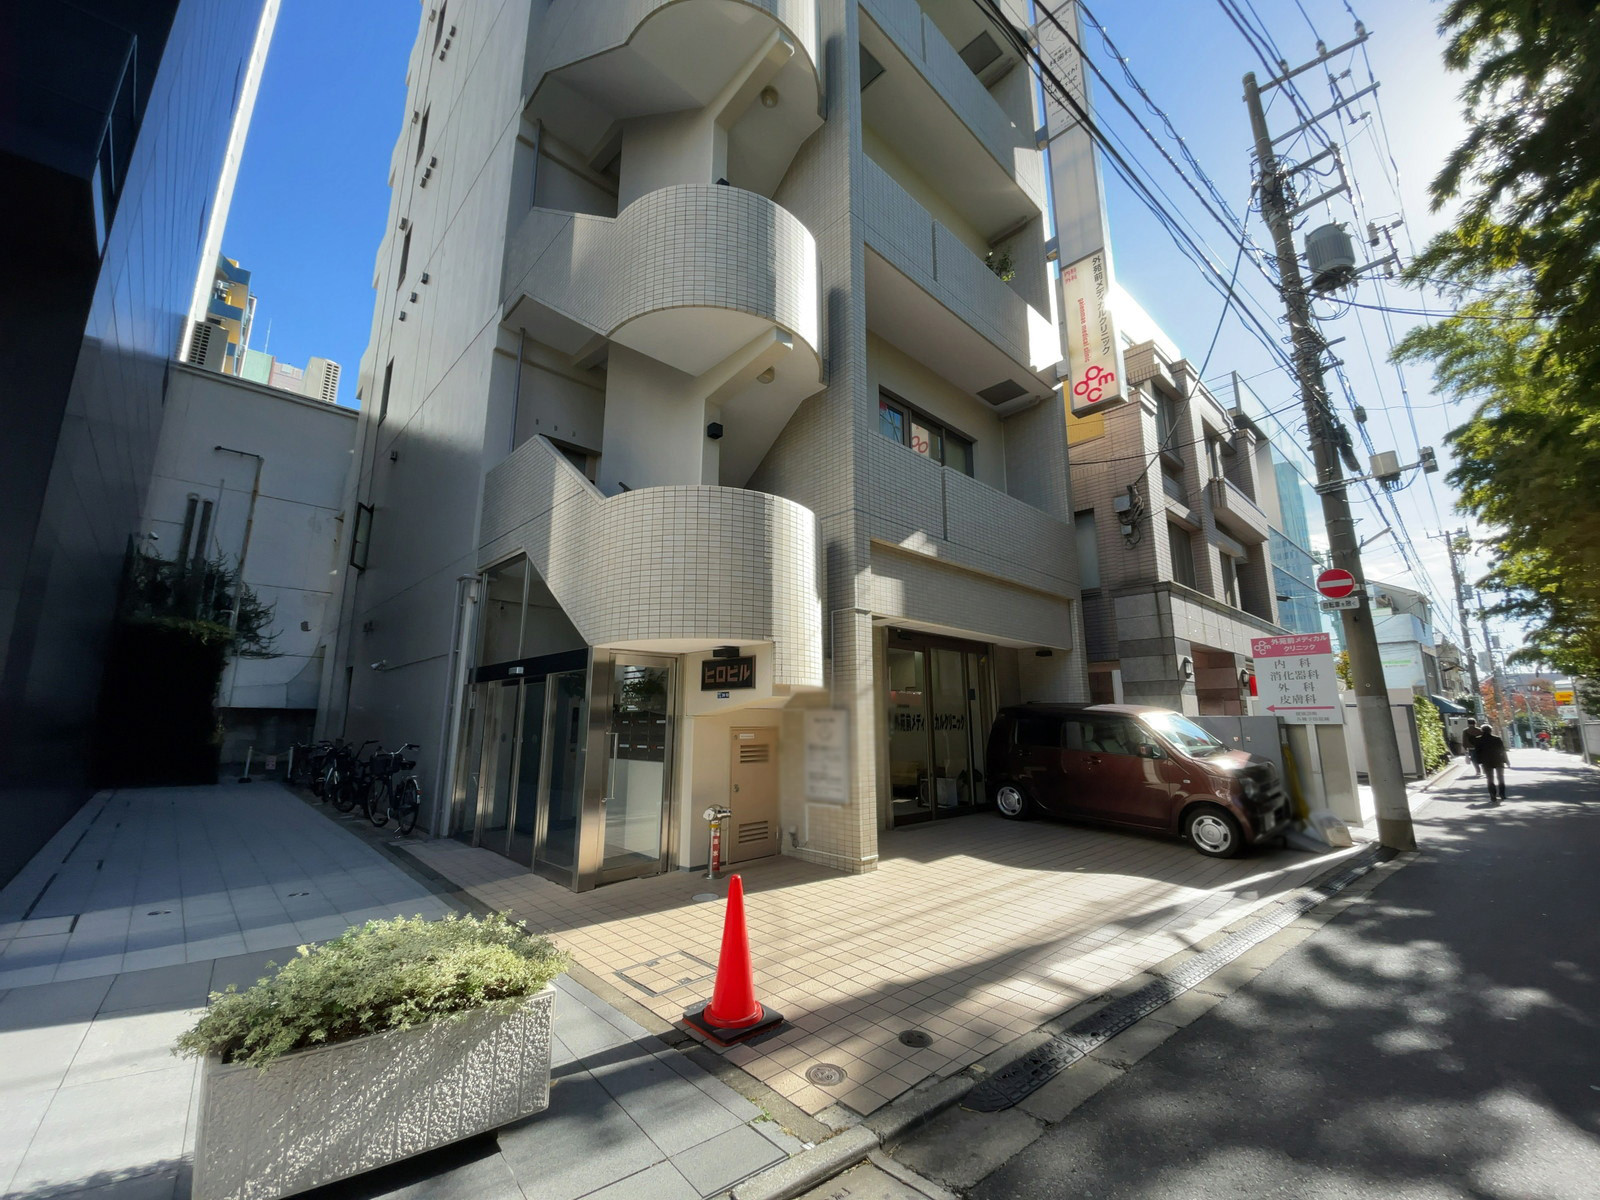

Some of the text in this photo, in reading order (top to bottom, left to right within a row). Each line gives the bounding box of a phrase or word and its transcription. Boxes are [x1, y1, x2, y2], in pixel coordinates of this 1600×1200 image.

[1283, 644, 1316, 652] クリニック
[705, 664, 750, 683] ヒロビル
[1270, 669, 1319, 681] 消化器科
[1280, 694, 1317, 704] 皮膚科
